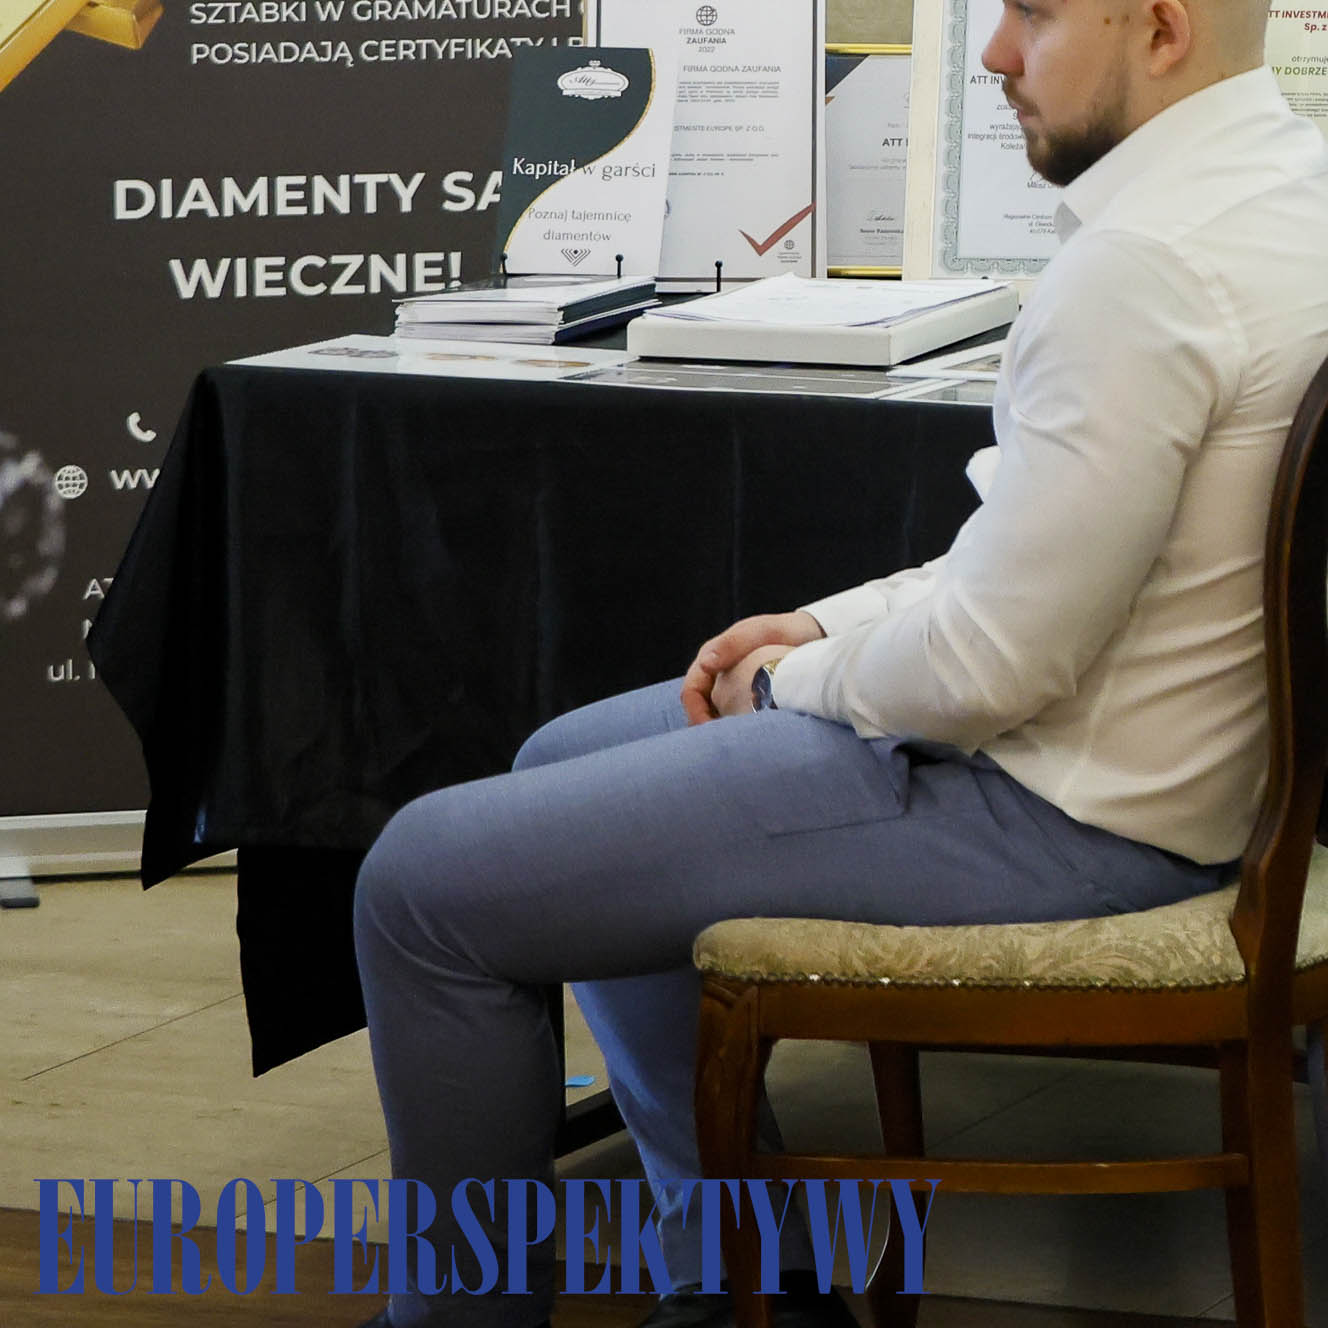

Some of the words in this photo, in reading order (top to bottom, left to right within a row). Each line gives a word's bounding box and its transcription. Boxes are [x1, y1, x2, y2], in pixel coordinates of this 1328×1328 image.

[189, 0, 309, 25] SZTABKI
[1267, 10, 1281, 18] TT
[1304, 22, 1320, 33] Sp.
[190, 39, 356, 69] POSIADAJĄ
[1284, 67, 1328, 76] DOBRZE
[882, 138, 902, 147] ATT
[512, 157, 577, 180] Kapitał
[582, 164, 596, 175] w
[602, 162, 656, 181] garści
[113, 173, 426, 221] DIAMENTY
[528, 208, 568, 222] Poznaj
[571, 209, 632, 223] tajemnicę
[543, 228, 613, 242] diamentów
[169, 251, 463, 300] WIECZNE!
[48, 658, 81, 682] ul.
